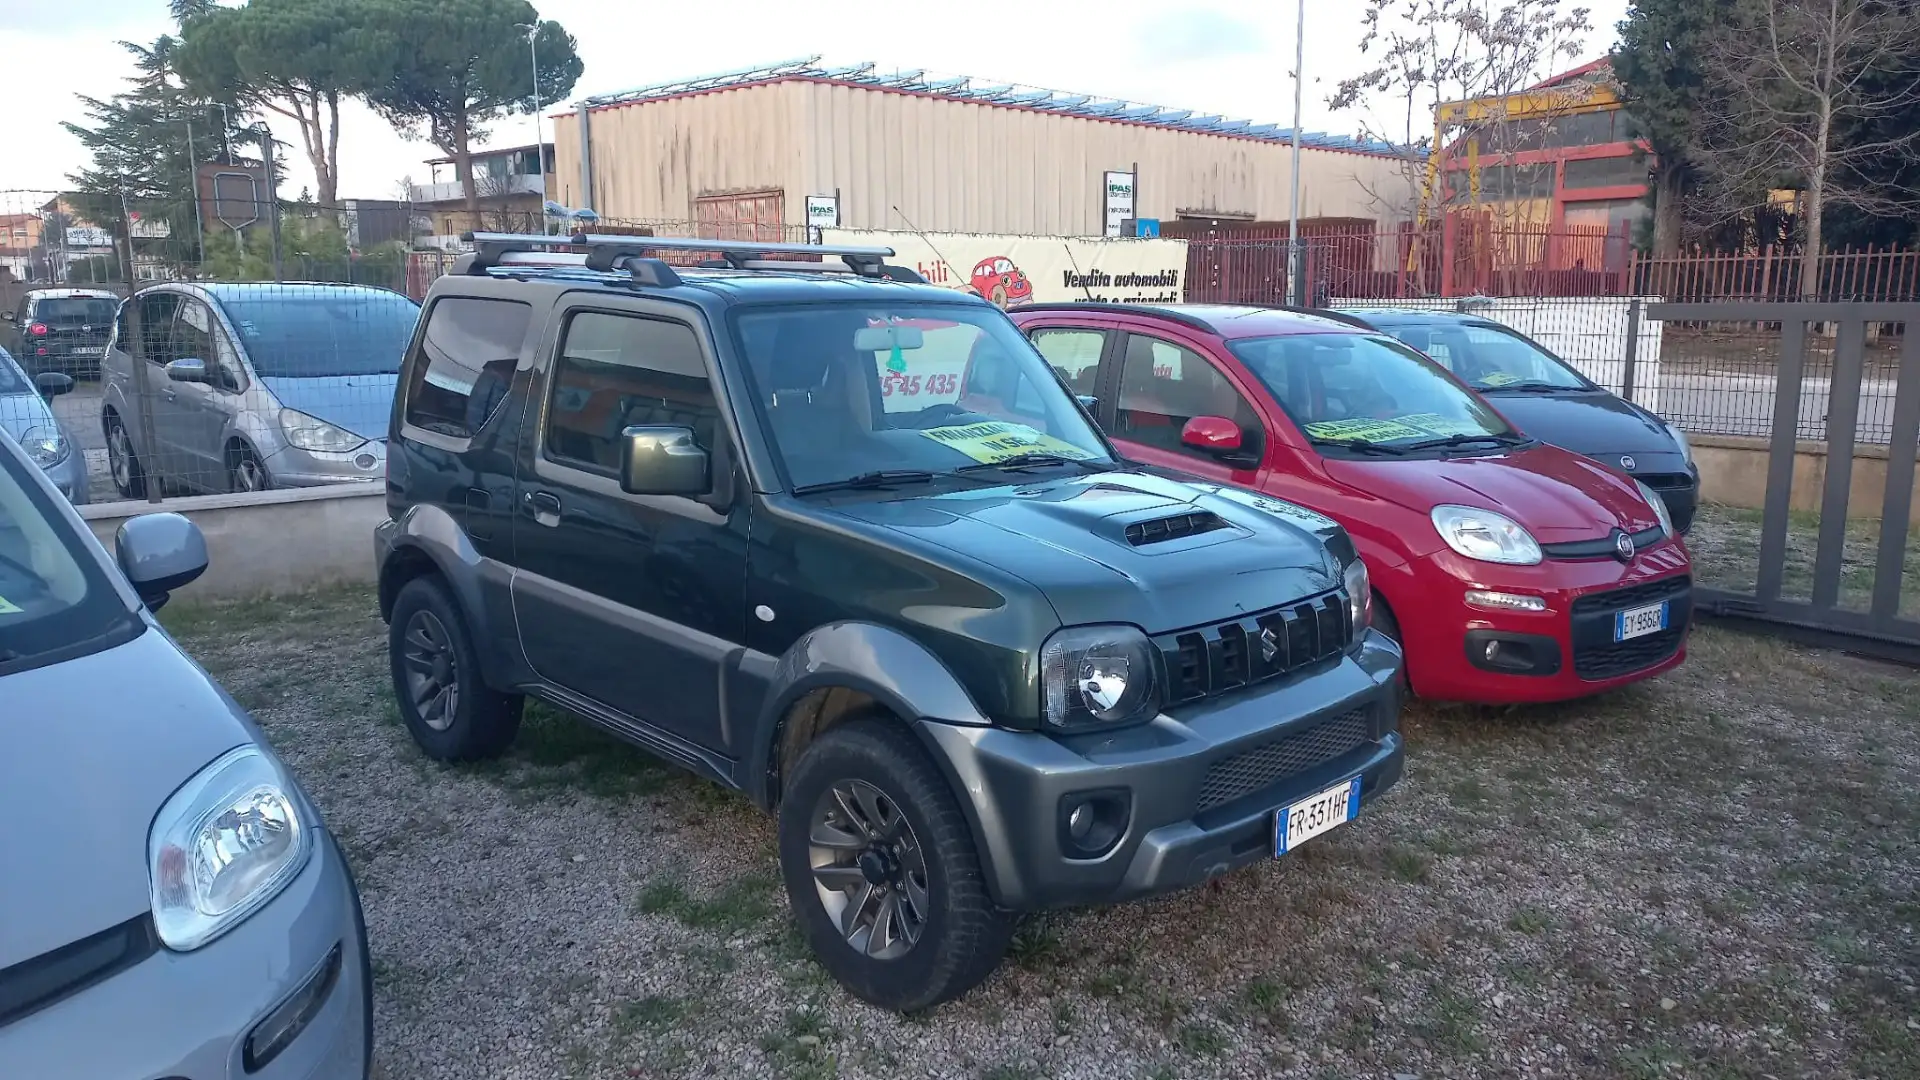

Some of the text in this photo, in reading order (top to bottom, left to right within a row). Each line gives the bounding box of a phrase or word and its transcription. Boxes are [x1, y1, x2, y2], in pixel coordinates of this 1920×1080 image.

[1063, 269, 1178, 287] Vendita automobili
[925, 373, 958, 395] 435
[1288, 809, 1304, 840] FR
